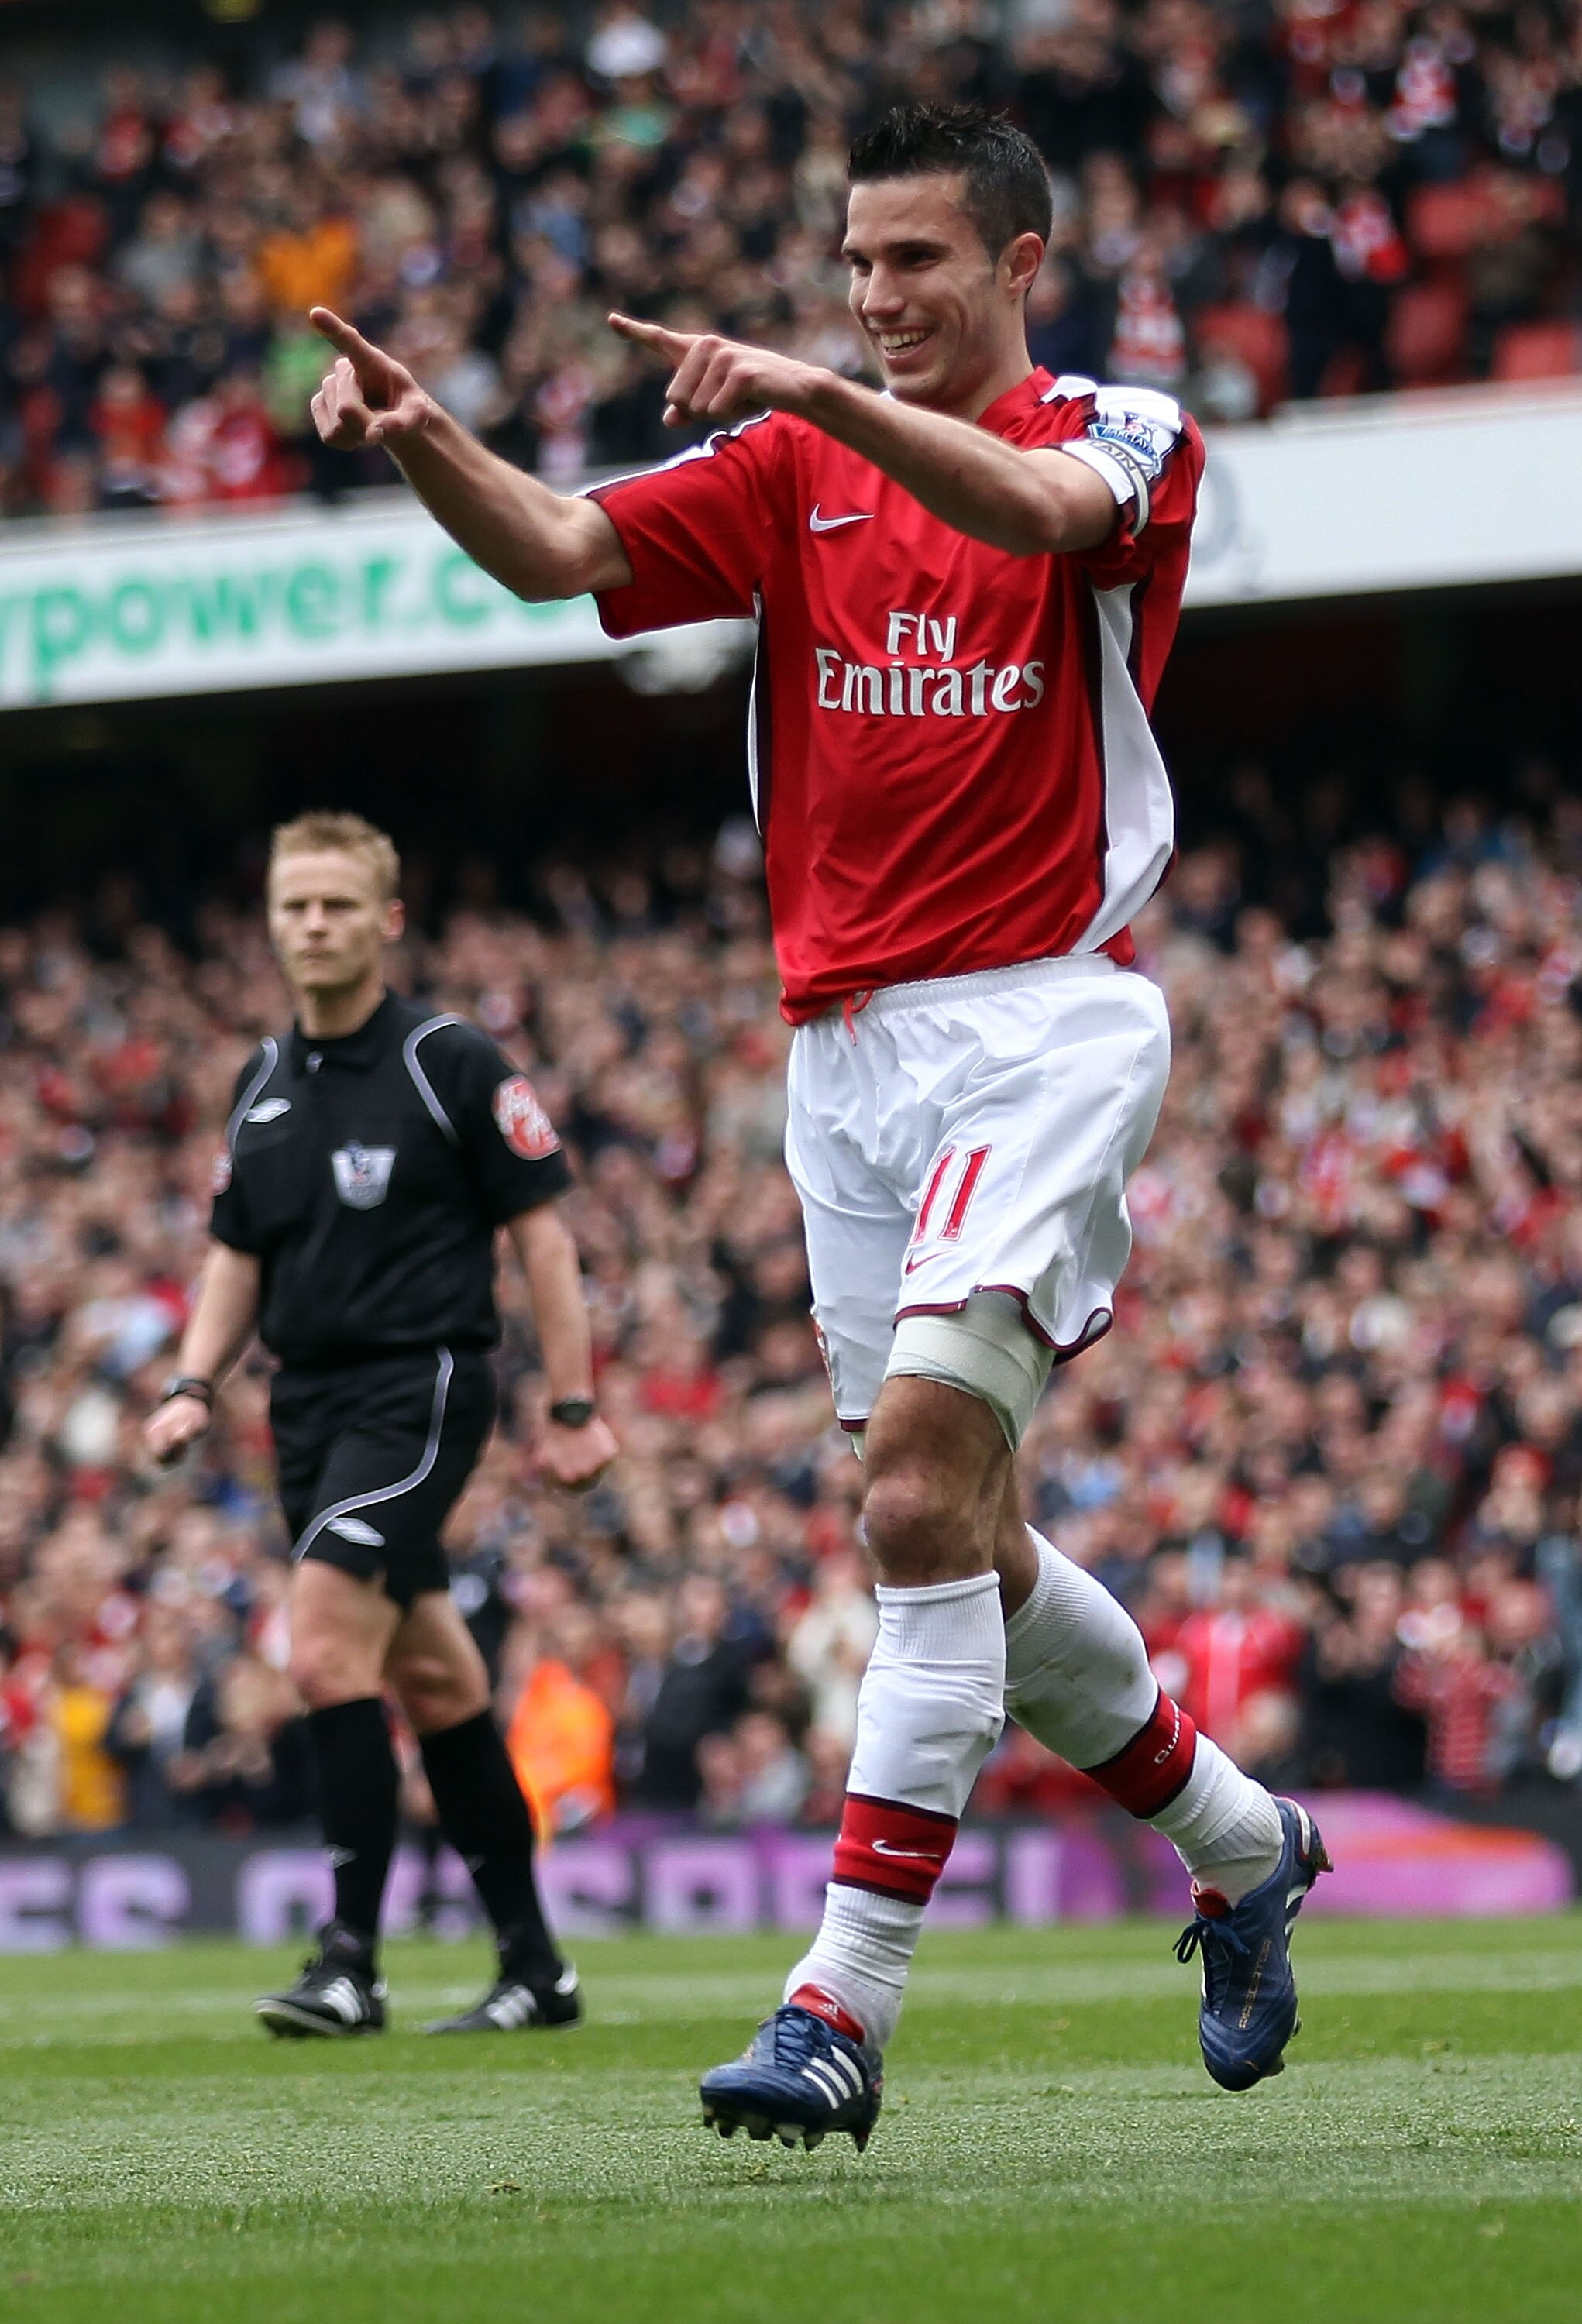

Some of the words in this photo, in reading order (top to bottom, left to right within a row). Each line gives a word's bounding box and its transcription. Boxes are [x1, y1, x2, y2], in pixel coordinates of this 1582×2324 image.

[886, 610, 957, 662] Fly
[815, 648, 1045, 717] Emirates
[910, 1143, 993, 1246] 11
